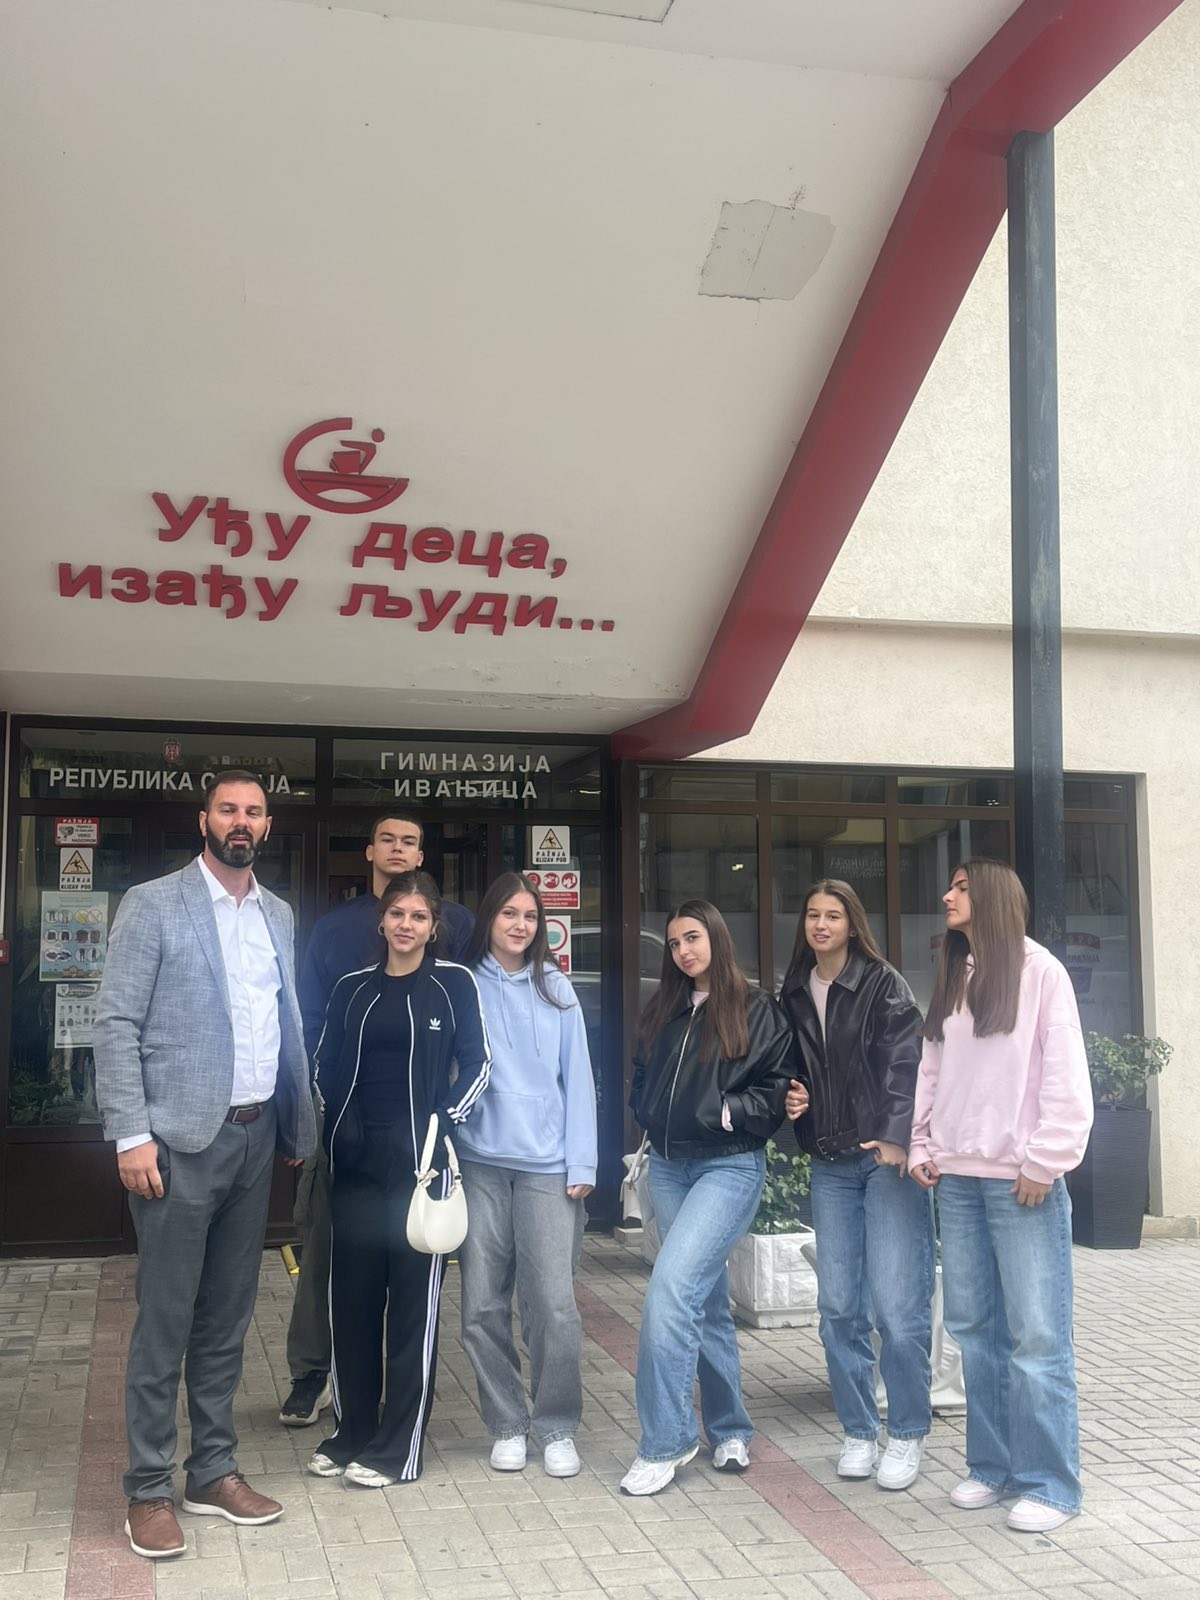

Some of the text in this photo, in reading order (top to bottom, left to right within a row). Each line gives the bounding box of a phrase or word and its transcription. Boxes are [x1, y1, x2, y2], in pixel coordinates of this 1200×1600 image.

[152, 492, 567, 578] Уђу деца,
[58, 562, 298, 621] изађу
[381, 752, 551, 773] ГИМНАЗИЈА
[49, 767, 291, 794] РЕПУБЛИКА СЈА
[394, 779, 538, 800] ИВАЊИЦА
